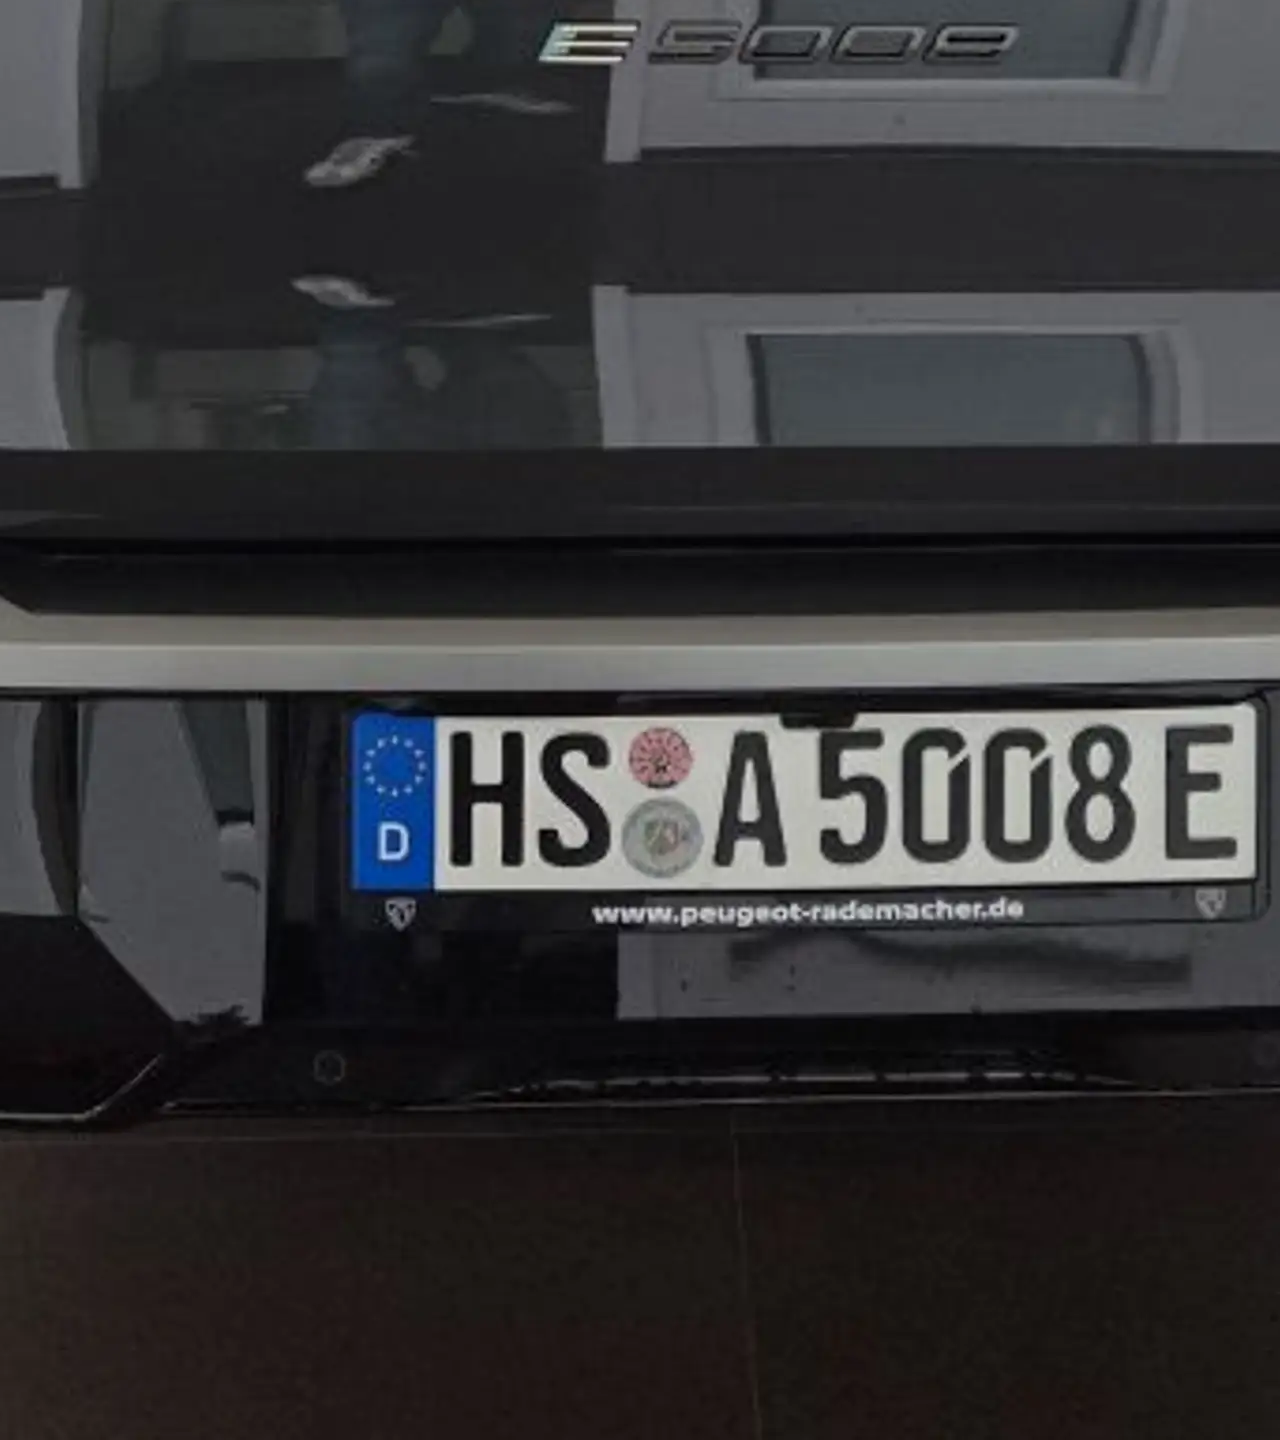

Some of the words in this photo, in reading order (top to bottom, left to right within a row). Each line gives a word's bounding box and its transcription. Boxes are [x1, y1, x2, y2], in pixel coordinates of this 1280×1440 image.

[378, 820, 409, 862] D
[449, 731, 612, 868] HS
[592, 898, 1025, 928] www.peugeot-rademacher.de
